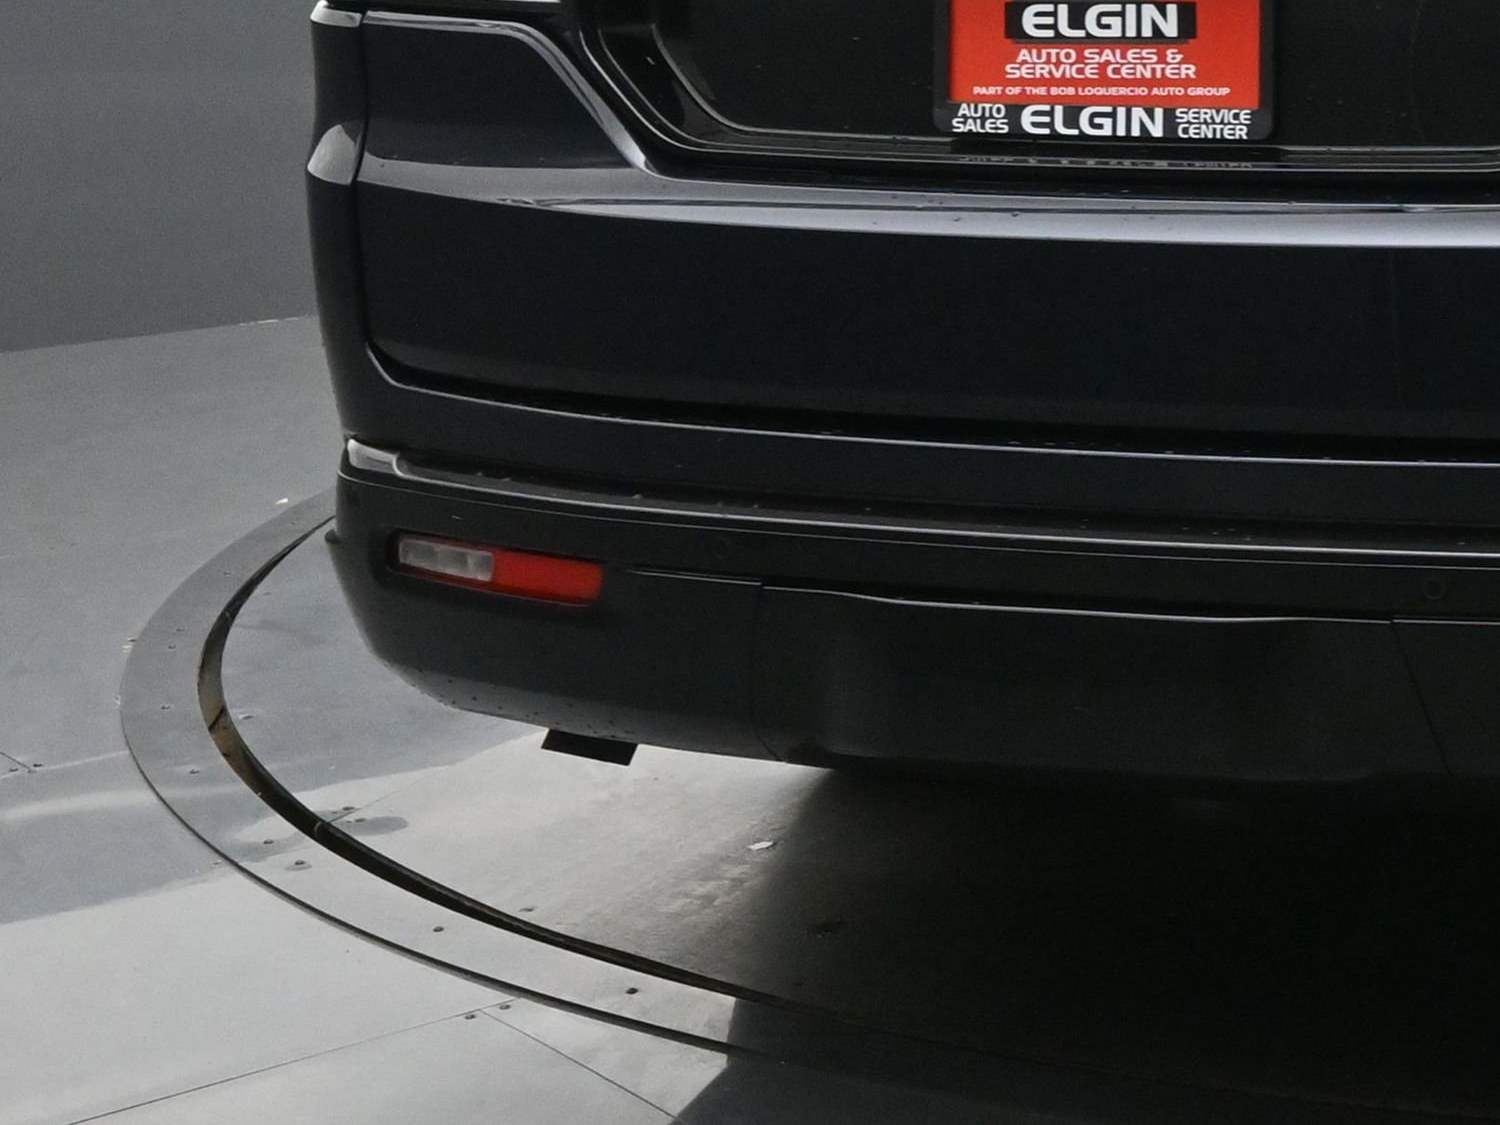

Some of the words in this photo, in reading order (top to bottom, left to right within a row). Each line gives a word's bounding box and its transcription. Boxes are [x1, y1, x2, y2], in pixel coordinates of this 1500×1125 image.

[1021, 3, 1179, 38] ELGIN
[1016, 48, 1077, 63] AUTO
[1084, 48, 1158, 63] SALES
[1166, 49, 1184, 63] &
[1005, 64, 1100, 79] SERVICE
[1106, 64, 1197, 79] CENTER
[973, 86, 1003, 96] PART
[1005, 86, 1023, 96] OF
[1024, 86, 1048, 96] THE
[1050, 86, 1077, 96] BOB
[1078, 86, 1149, 96] LOQUERCIO
[1150, 86, 1185, 96] AUTO
[1187, 86, 1231, 96] GROUP
[957, 103, 1006, 118] AUTO
[1175, 108, 1252, 124] SERVICE
[951, 118, 1009, 134] SALES
[1020, 104, 1164, 138] ELGIN
[1177, 124, 1248, 140] CENTER
